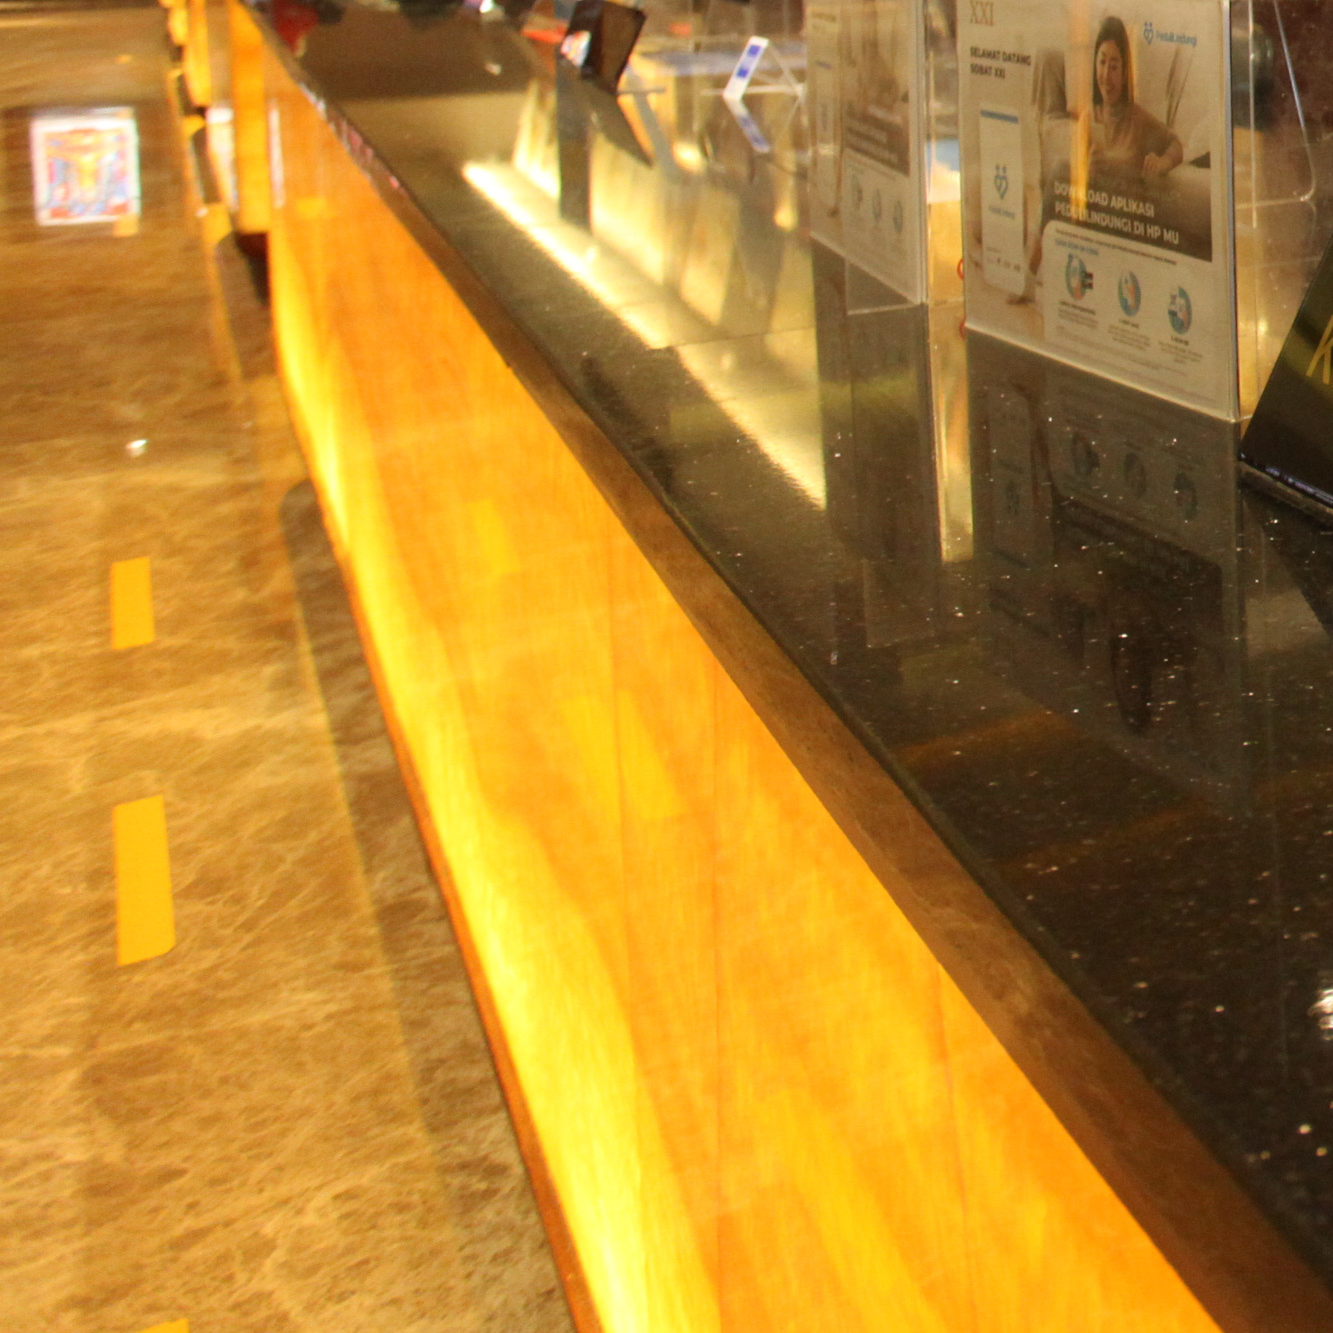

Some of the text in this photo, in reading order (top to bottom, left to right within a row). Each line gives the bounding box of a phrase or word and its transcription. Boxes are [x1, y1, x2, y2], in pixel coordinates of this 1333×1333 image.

[969, 0, 995, 27] XXI
[1110, 195, 1154, 218] APLIKASI
[1134, 221, 1145, 236] DI
[1147, 225, 1161, 240] HP
[1163, 228, 1180, 244] MU
